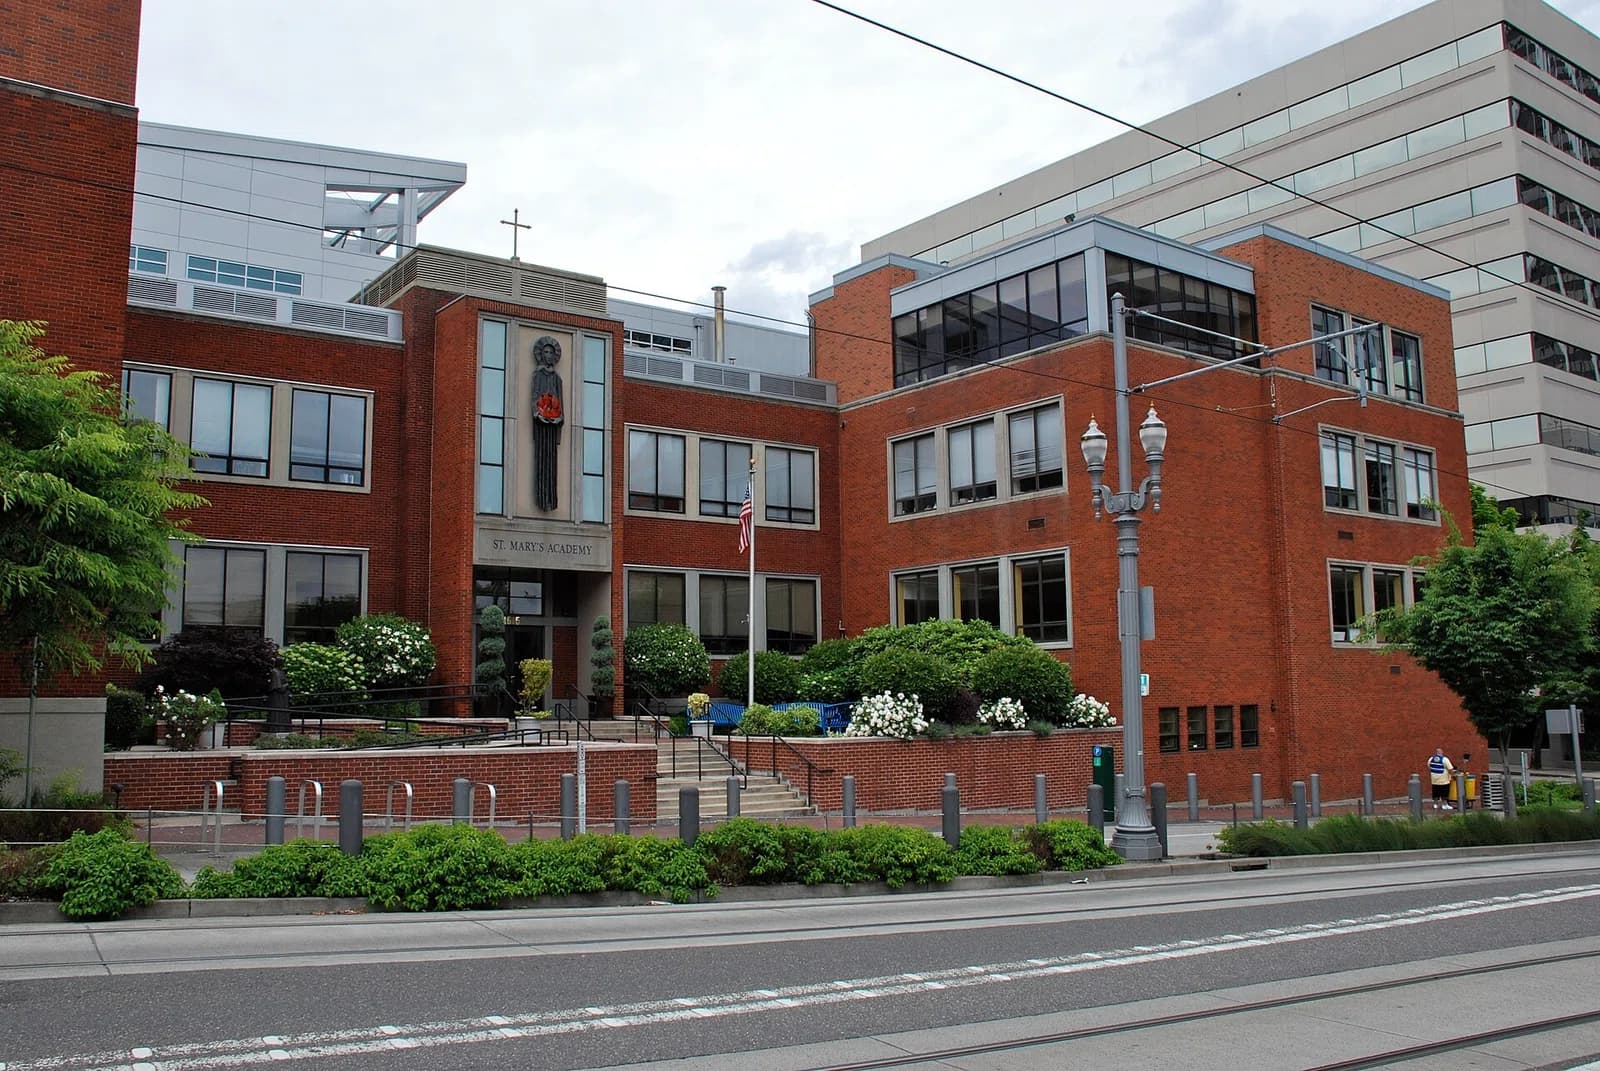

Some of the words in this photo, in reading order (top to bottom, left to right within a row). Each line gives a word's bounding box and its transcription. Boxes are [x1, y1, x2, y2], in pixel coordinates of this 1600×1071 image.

[493, 539, 506, 550] ST.
[510, 540, 544, 552] MARY'S
[547, 543, 593, 555] ACADEMY
